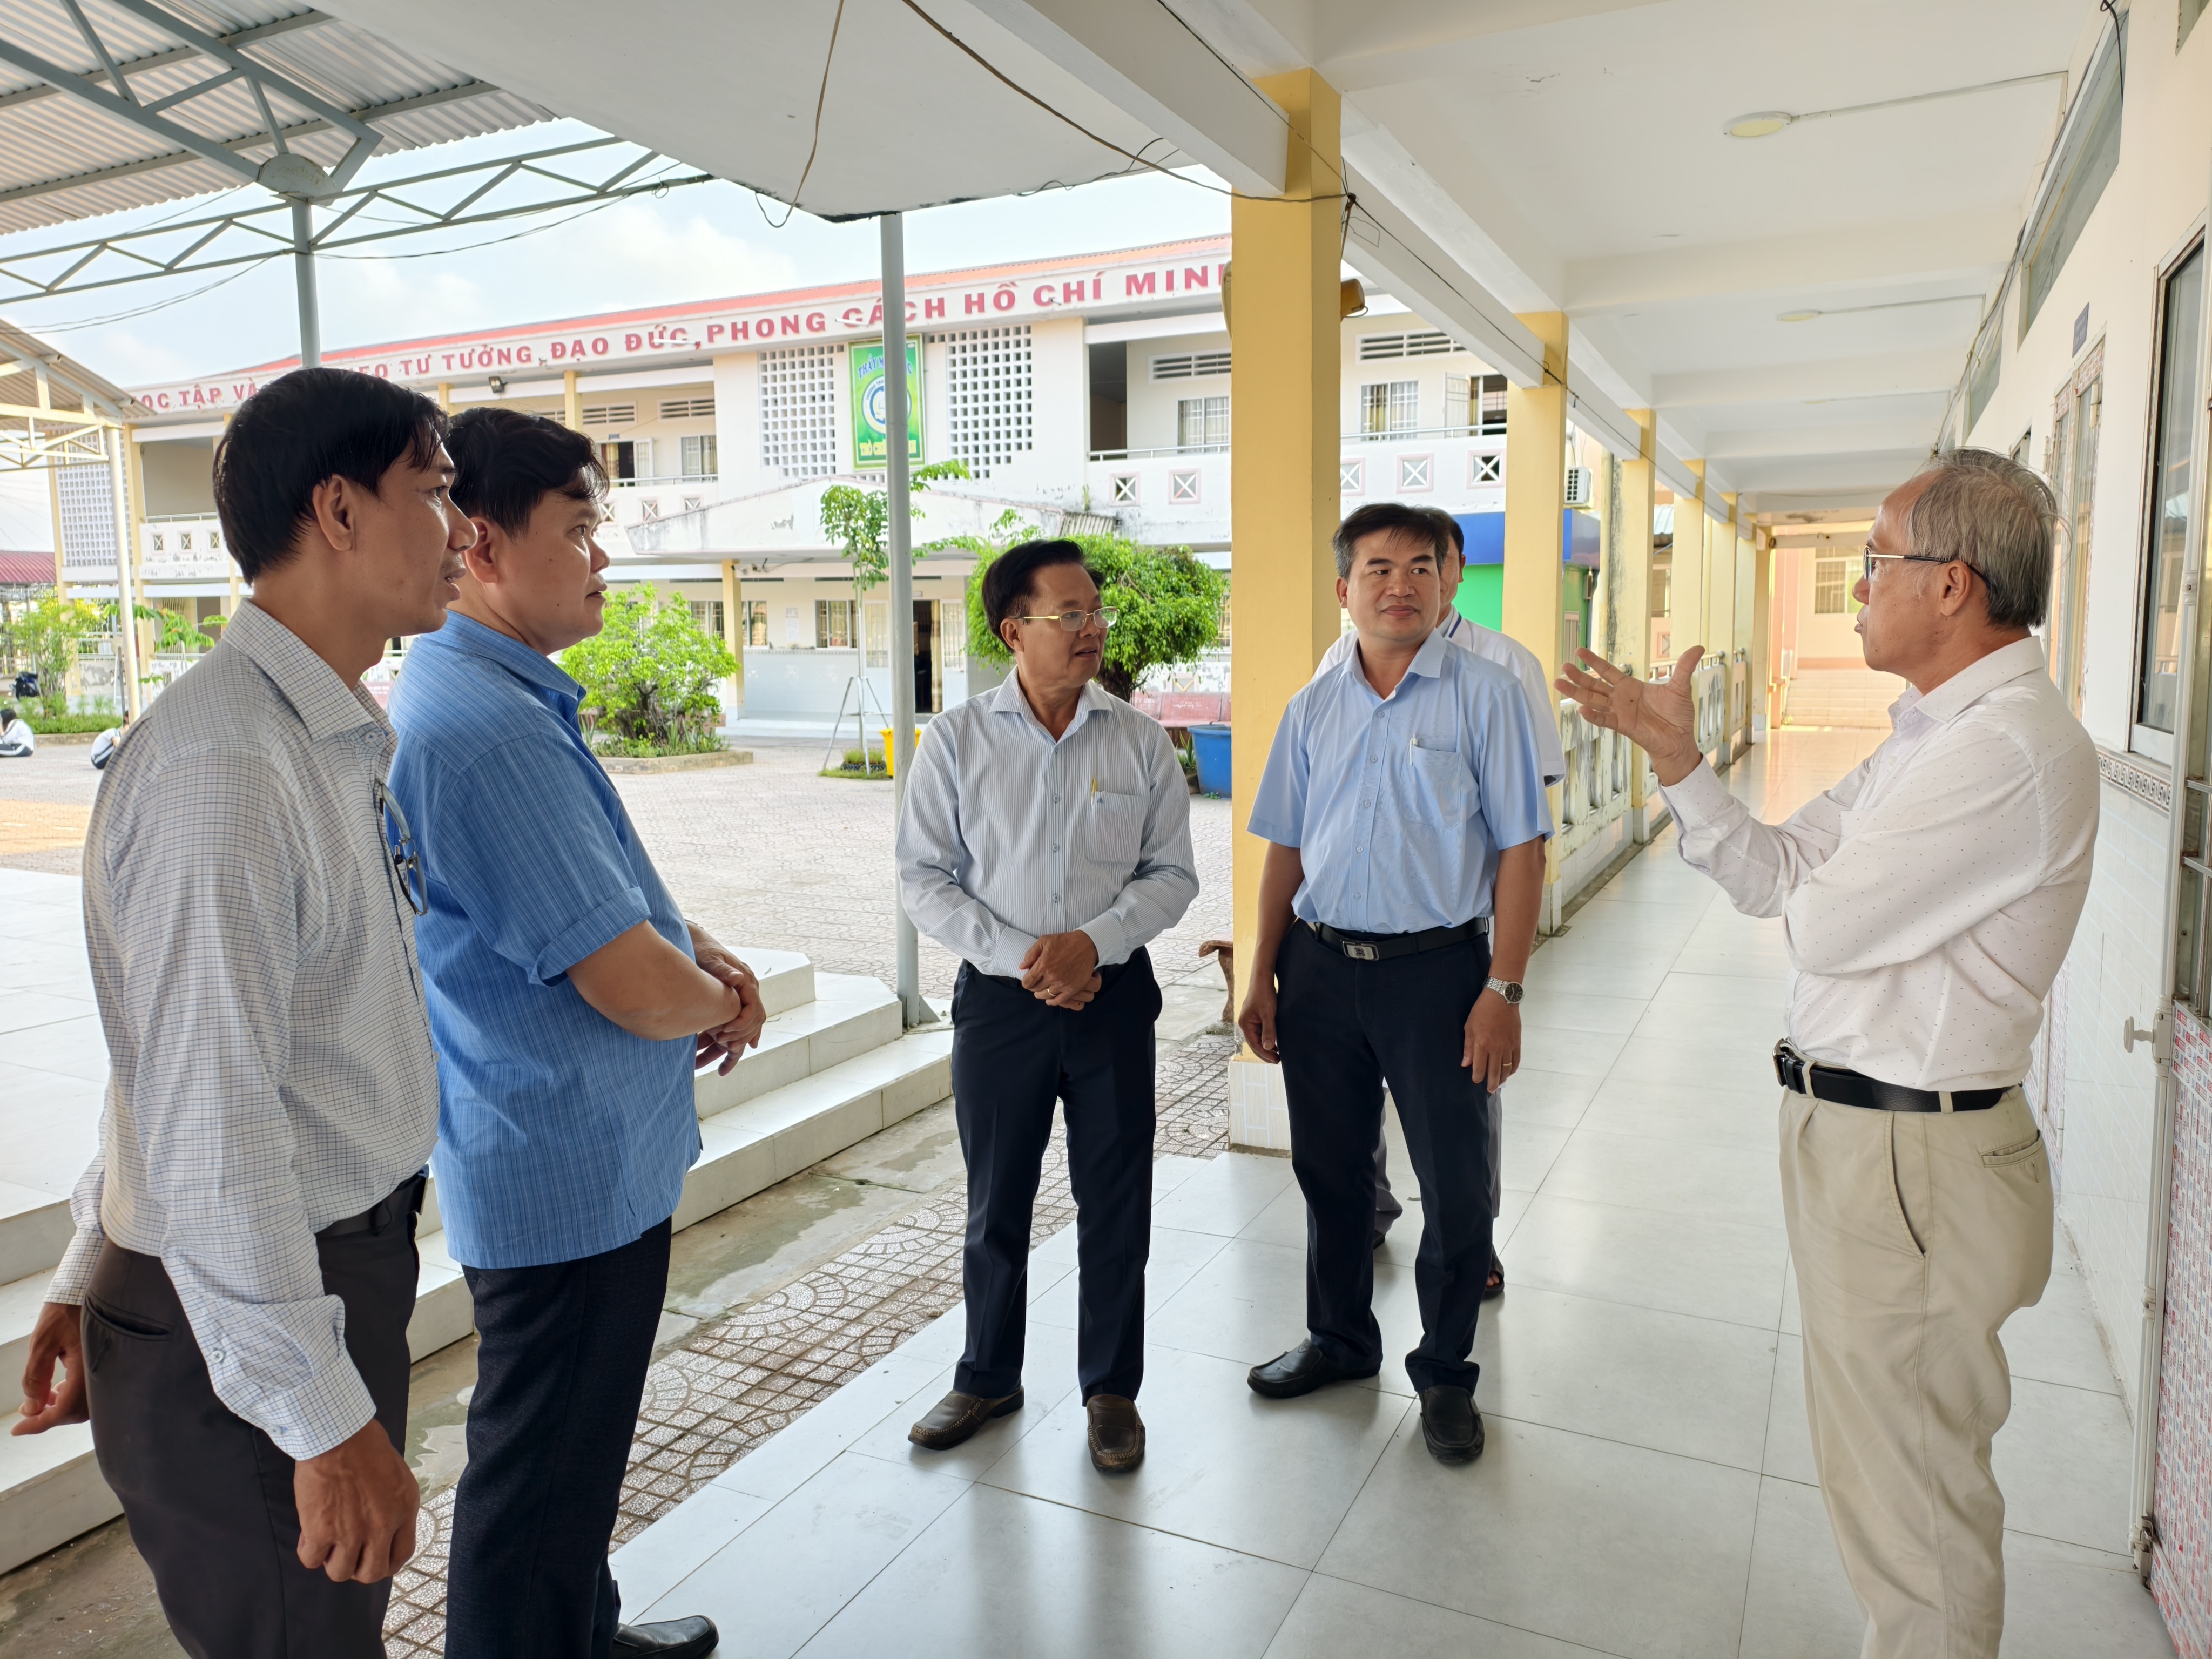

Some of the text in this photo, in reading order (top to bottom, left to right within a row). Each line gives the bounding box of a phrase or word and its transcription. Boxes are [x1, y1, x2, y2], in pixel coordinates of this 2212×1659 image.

[179, 383, 221, 410] TẬP
[233, 377, 258, 401] VÀ
[400, 354, 431, 375] TƯ
[550, 337, 609, 361] ĐẠO
[707, 312, 826, 343] PHONG
[965, 281, 1019, 314] HỒ
[1033, 271, 1106, 307] CHÍ
